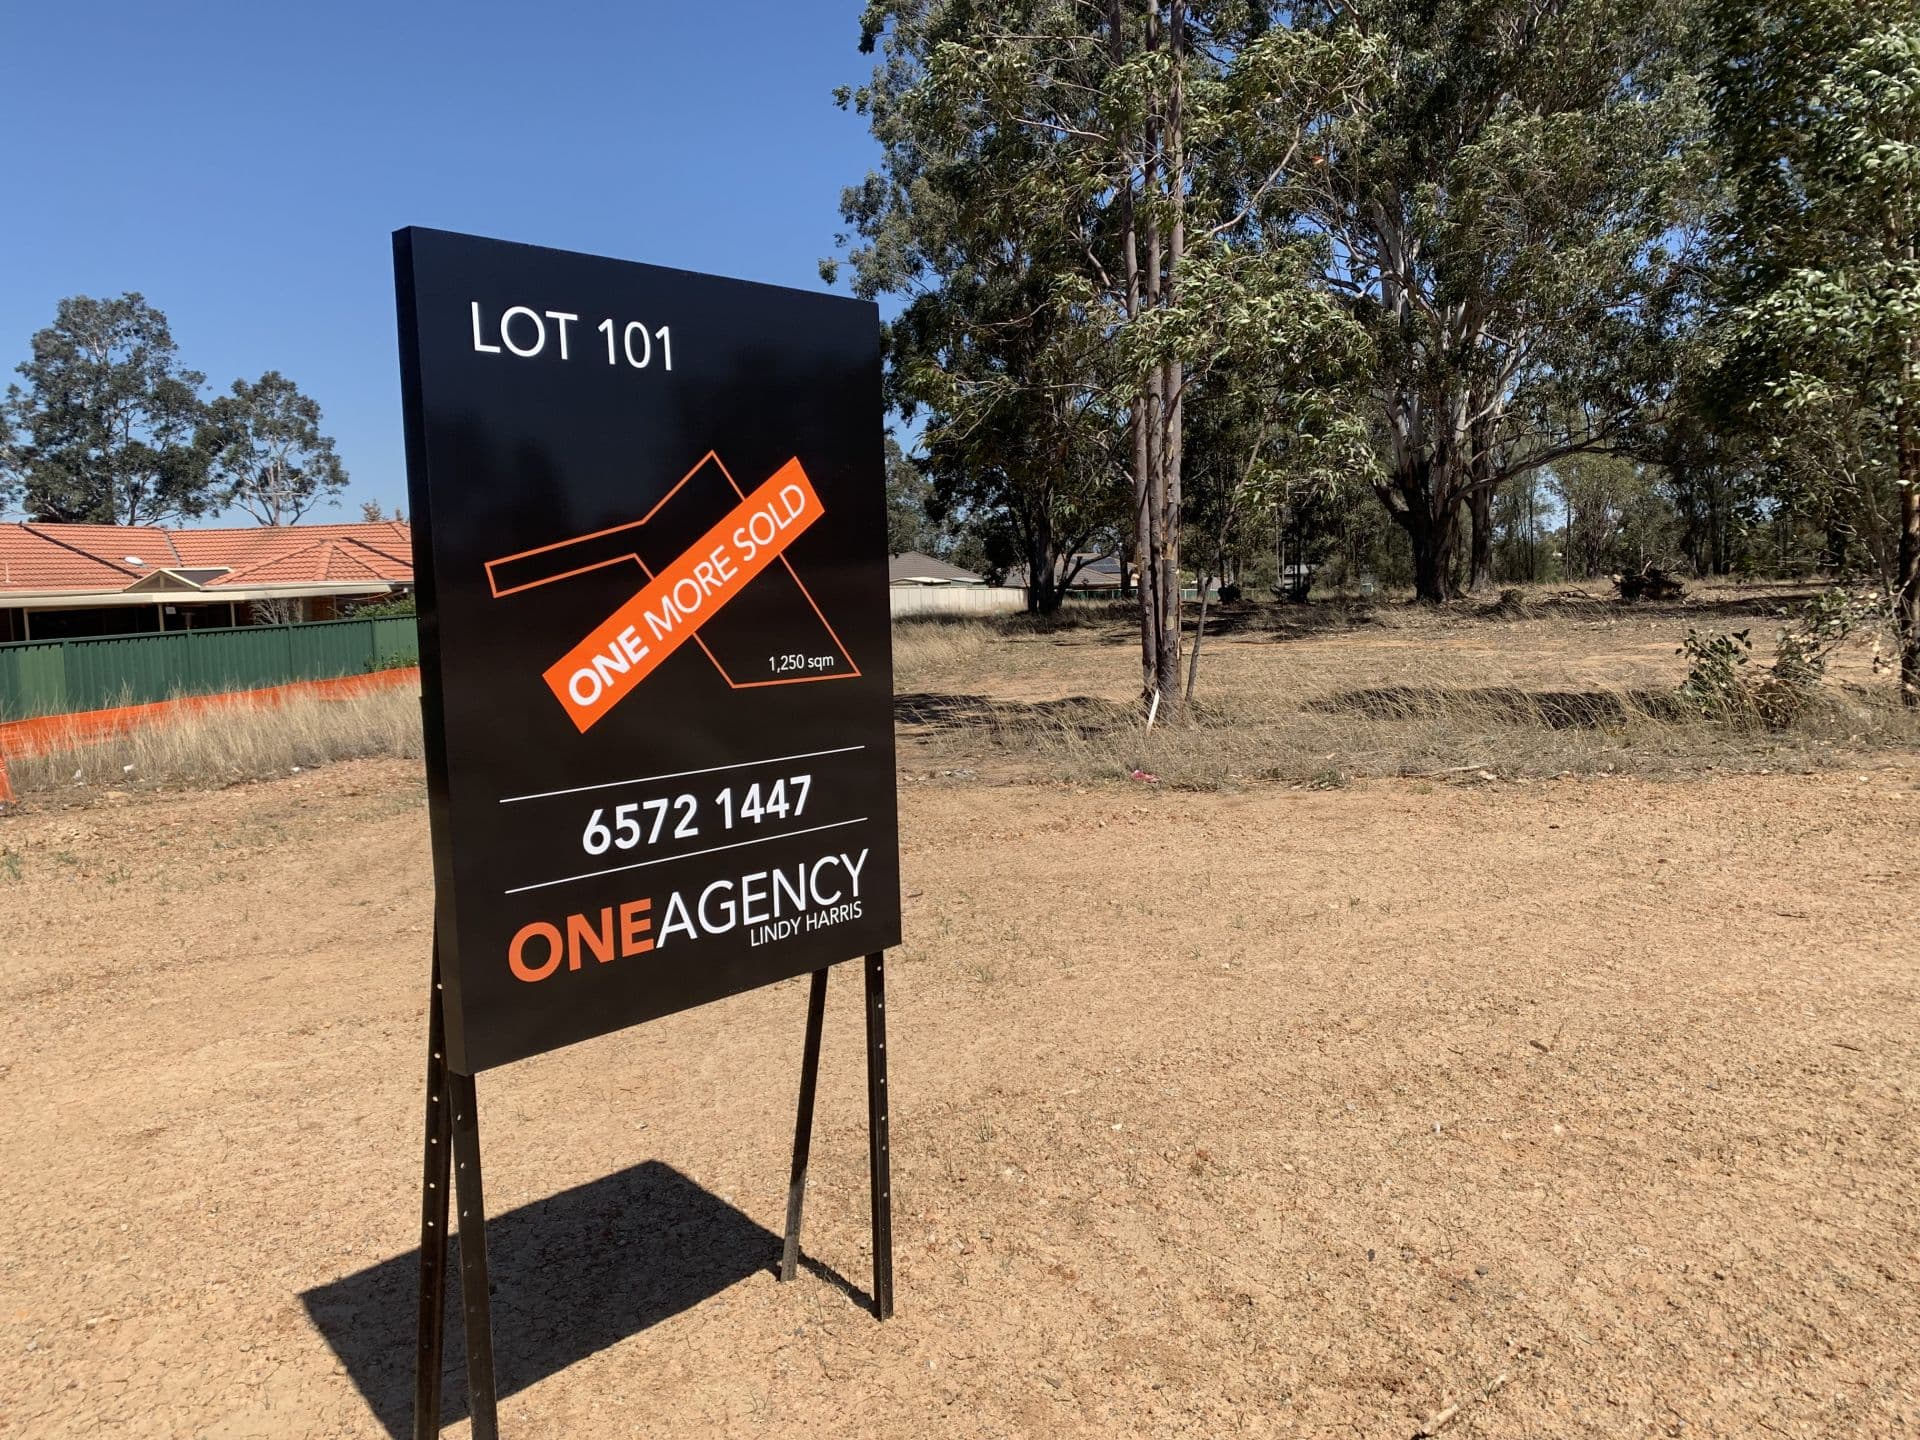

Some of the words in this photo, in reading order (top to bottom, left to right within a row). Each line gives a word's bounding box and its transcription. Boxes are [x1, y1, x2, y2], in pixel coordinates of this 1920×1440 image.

[471, 301, 578, 360] LOT
[598, 318, 672, 371] 101
[568, 625, 649, 706] ONE
[643, 545, 738, 641] MORE
[732, 483, 806, 562] SOLD
[768, 653, 805, 673] 1,250
[807, 653, 835, 670] sqm
[582, 793, 699, 856] 6572
[715, 774, 811, 830] 1447
[750, 916, 800, 947] LINDY
[805, 900, 862, 932] HARRIS
